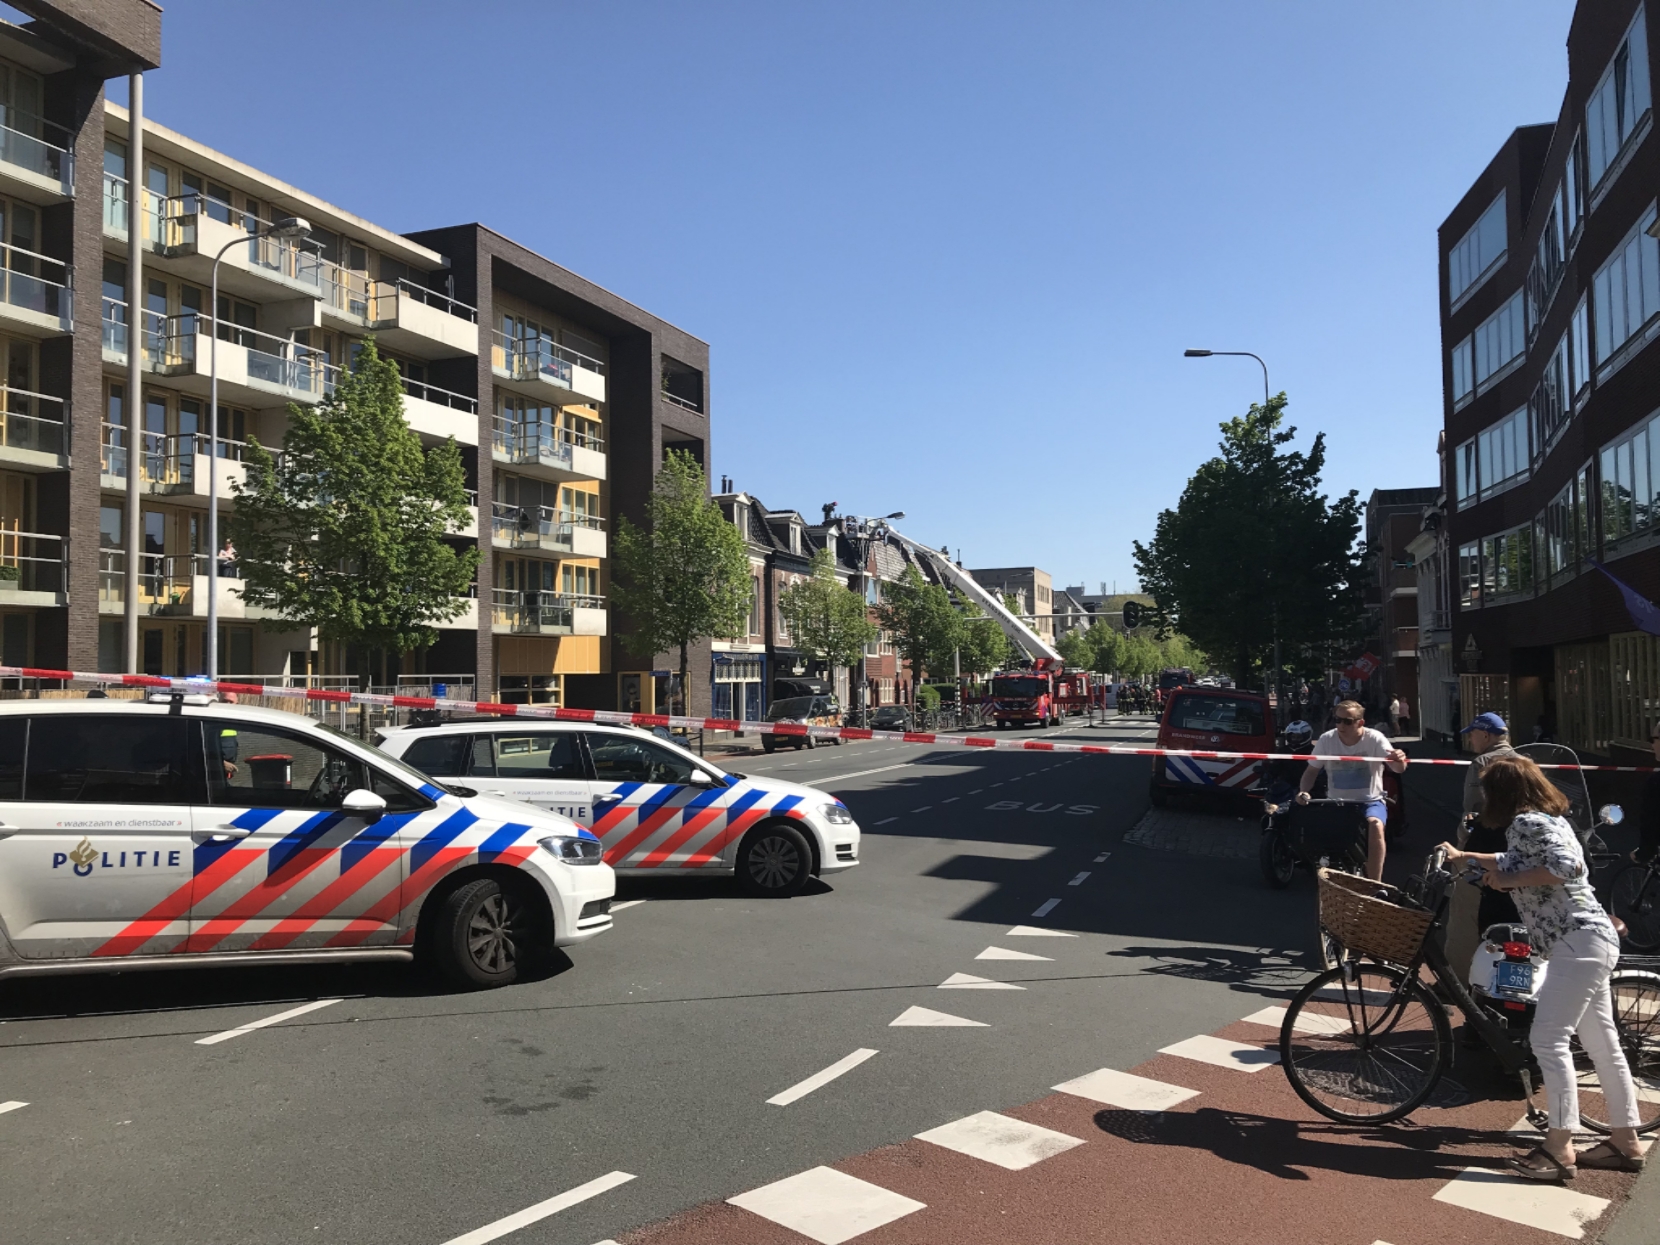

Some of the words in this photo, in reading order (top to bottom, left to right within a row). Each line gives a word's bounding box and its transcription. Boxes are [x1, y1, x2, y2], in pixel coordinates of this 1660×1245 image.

[983, 800, 1101, 815] BUS
[64, 820, 113, 828] waakzaam
[128, 819, 176, 827] dienstbaar
[52, 850, 181, 877] POLITIE
[1510, 964, 1531, 976] F96
[1509, 975, 1531, 987] 9RN
